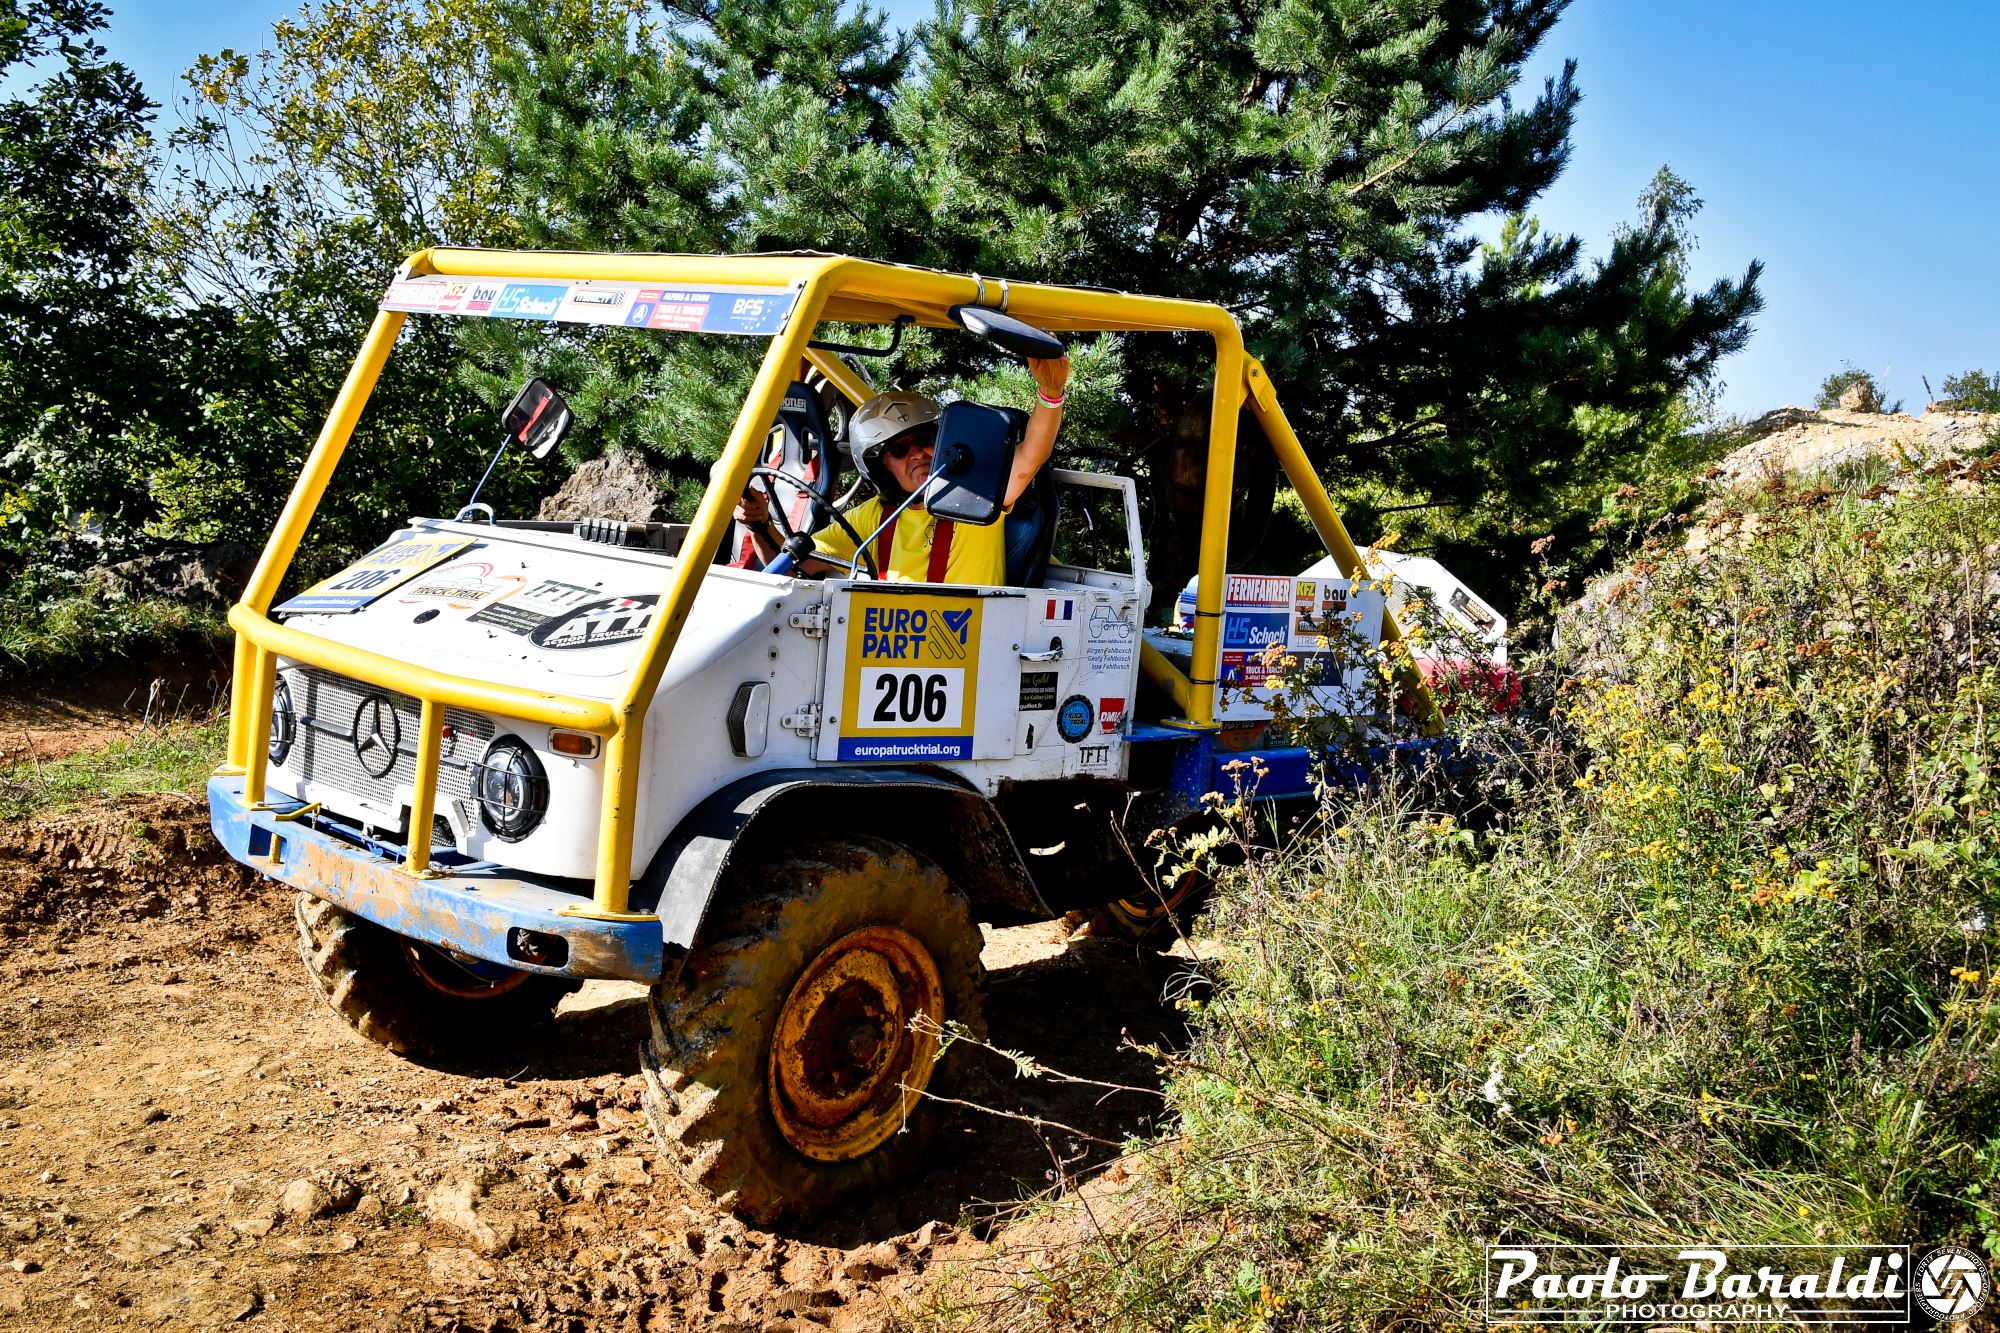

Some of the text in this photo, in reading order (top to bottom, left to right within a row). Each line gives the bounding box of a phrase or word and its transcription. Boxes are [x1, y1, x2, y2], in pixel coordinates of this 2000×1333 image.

[472, 286, 497, 301] bau
[732, 299, 765, 315] BFS
[329, 569, 401, 590] 206
[1227, 578, 1290, 602] FERNFAHRER
[1297, 582, 1316, 597] KFZ
[1324, 585, 1347, 601] bau
[864, 607, 928, 633] EURO
[541, 634, 587, 647] ACTION
[591, 629, 632, 639] TRUCK
[1225, 617, 1250, 644] HS
[1249, 625, 1286, 645] Schoch
[862, 633, 926, 659] PART
[872, 673, 948, 723] 206
[1101, 711, 1121, 722] DMV
[854, 743, 961, 758] europatrucktrial.org
